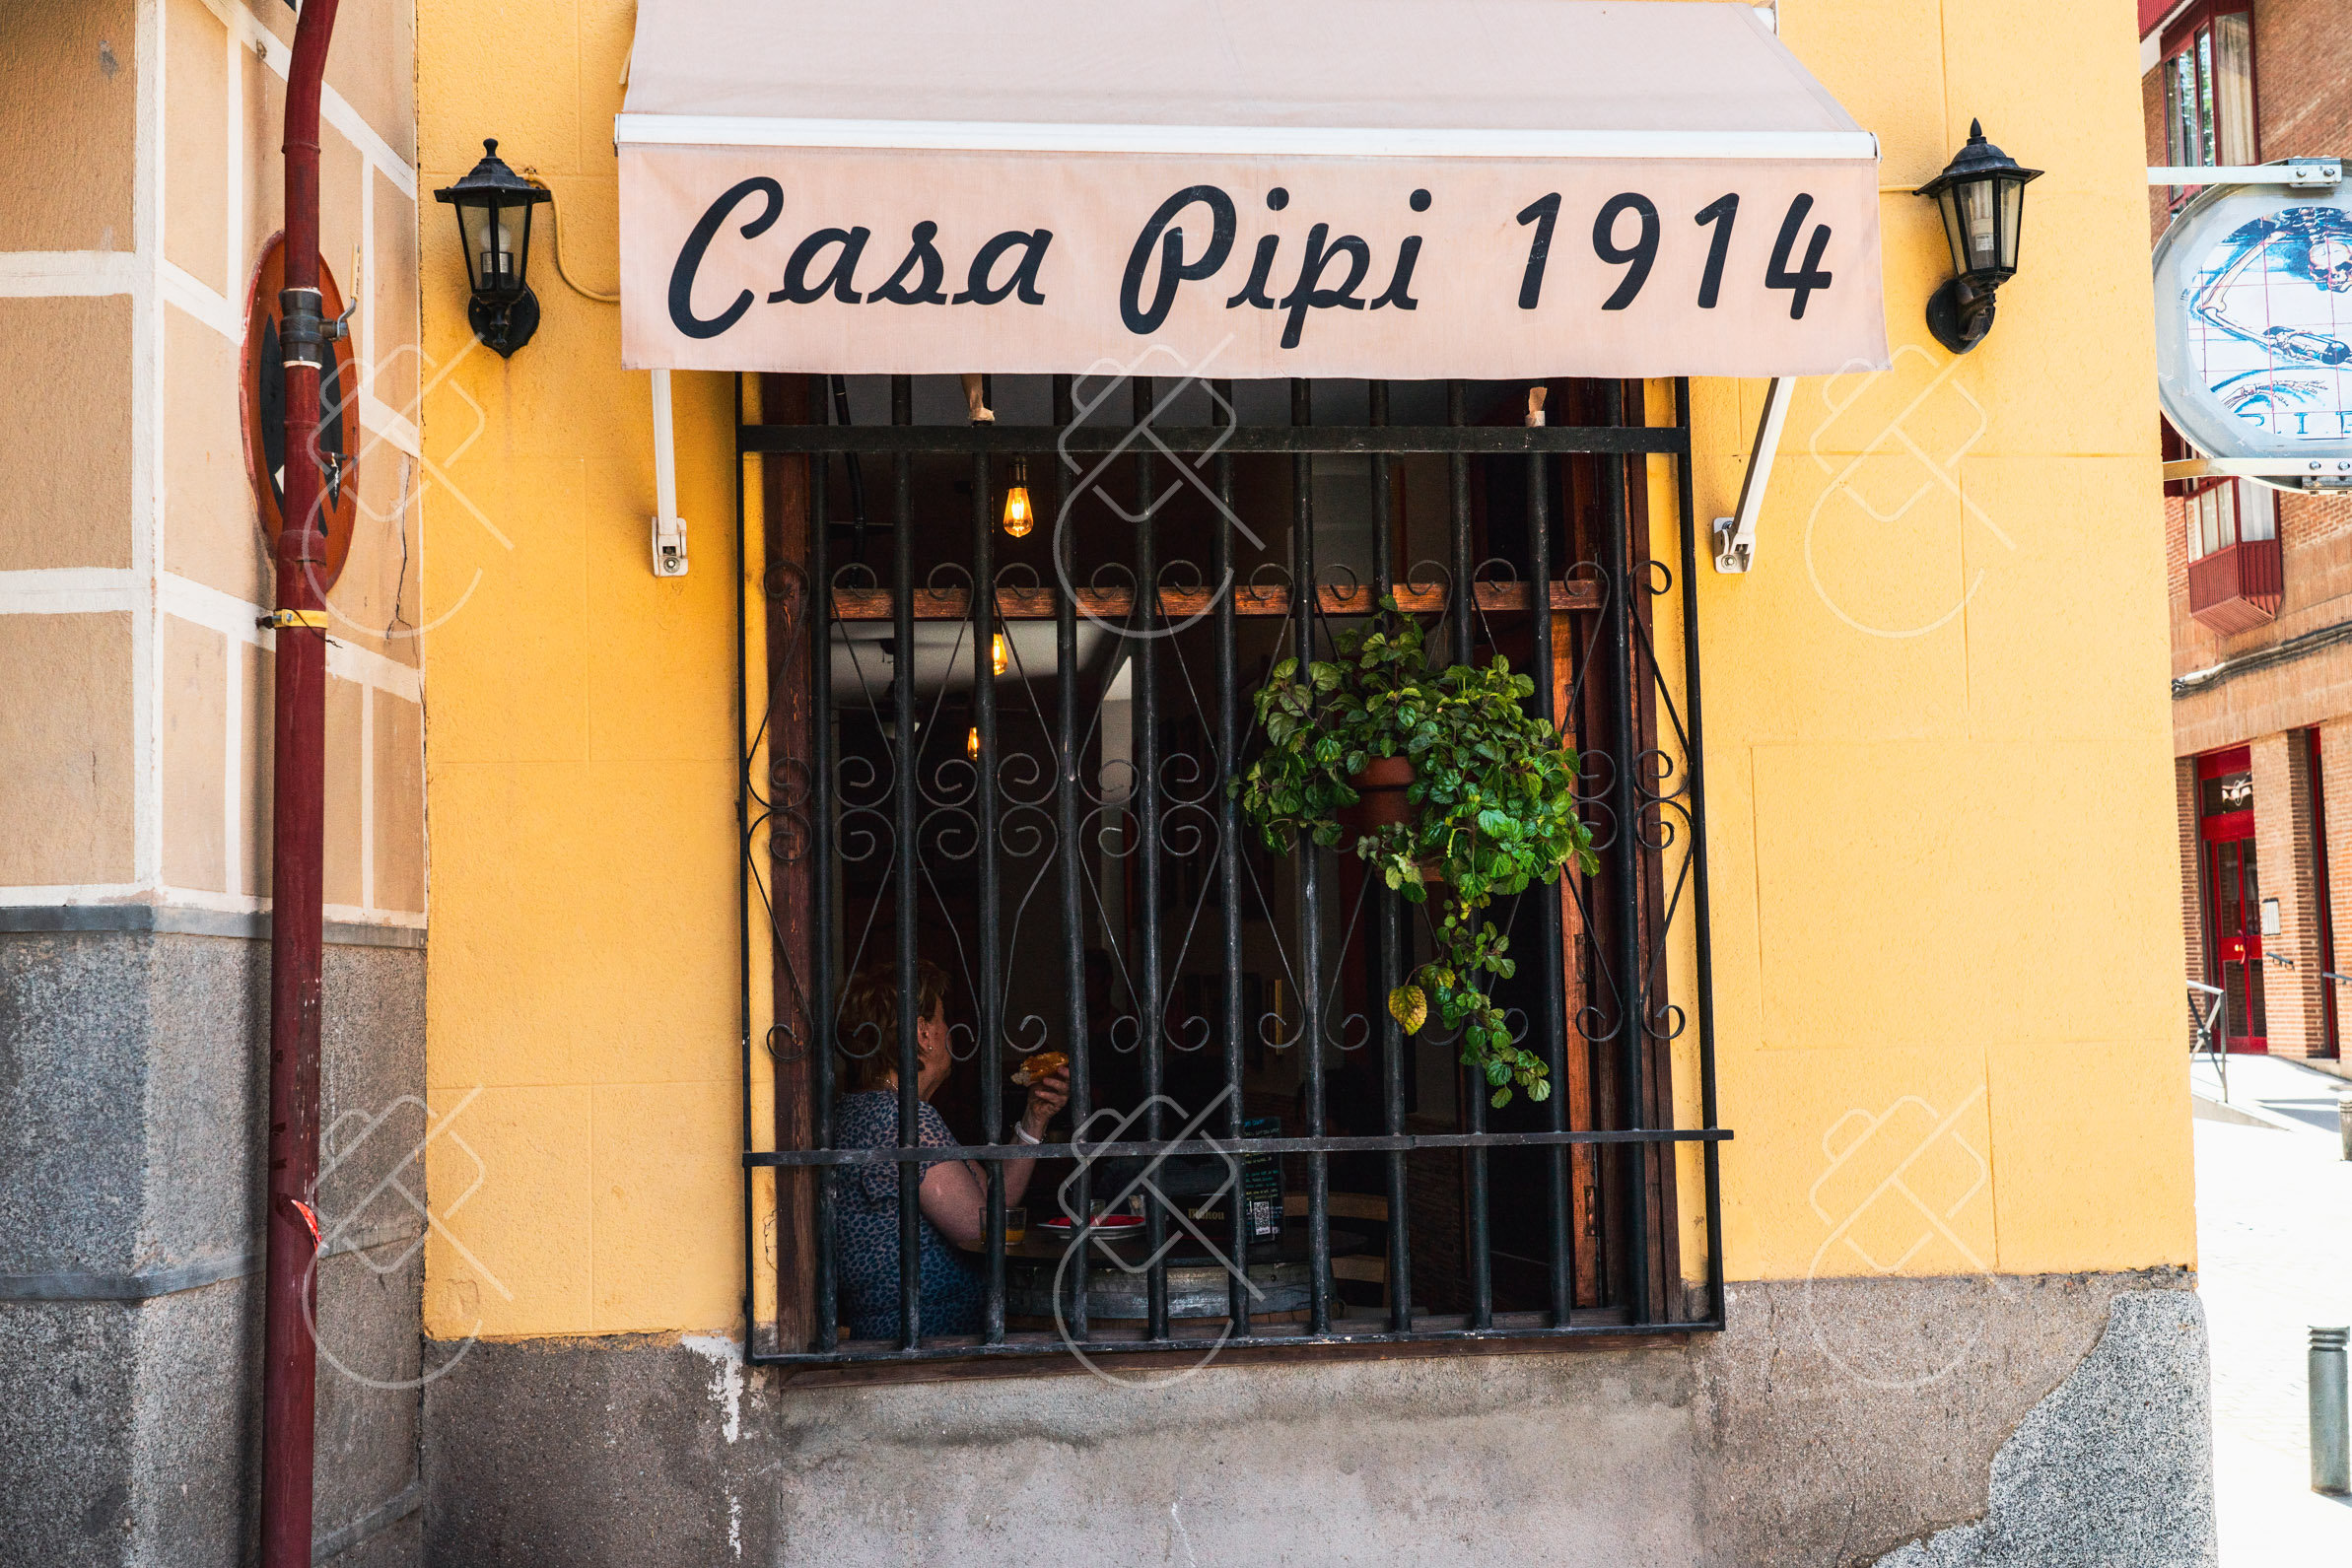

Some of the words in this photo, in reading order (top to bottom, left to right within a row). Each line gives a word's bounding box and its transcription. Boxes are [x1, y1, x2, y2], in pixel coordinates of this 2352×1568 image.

[667, 176, 1054, 340] Casa
[1119, 184, 1432, 350] Pipi
[1516, 192, 1833, 320] 1914
